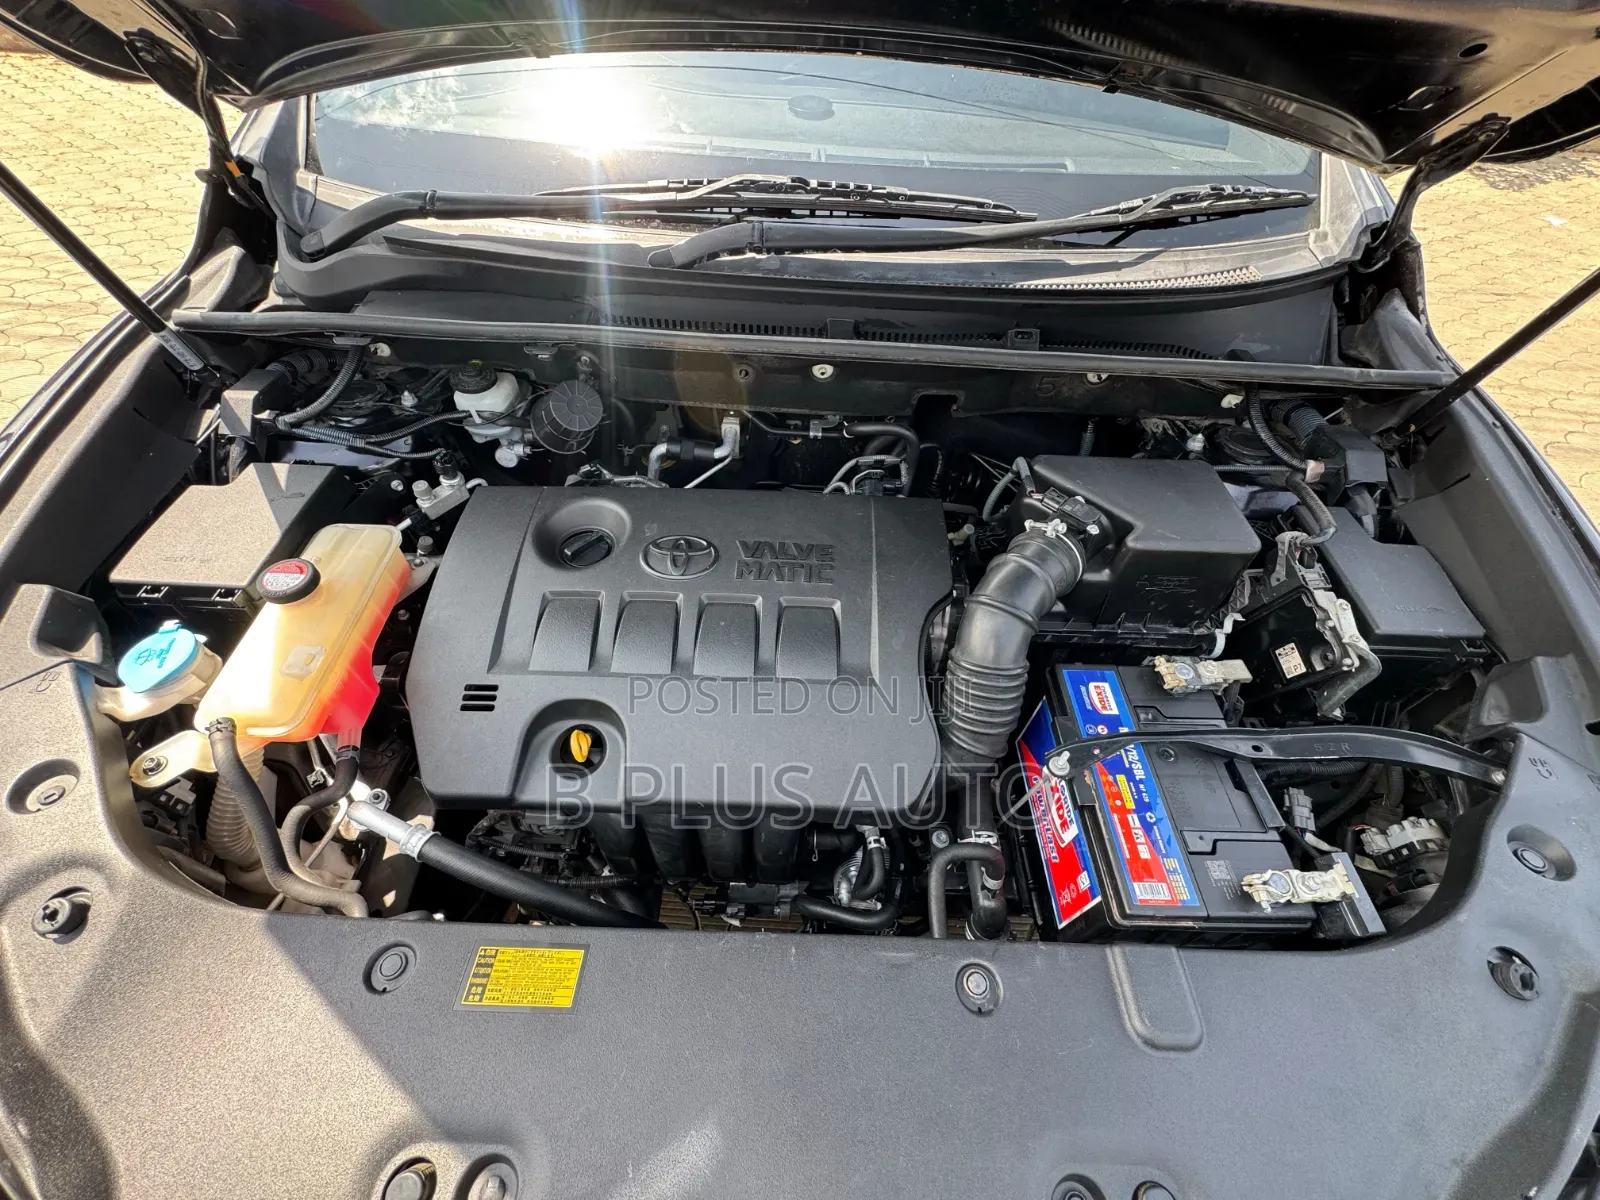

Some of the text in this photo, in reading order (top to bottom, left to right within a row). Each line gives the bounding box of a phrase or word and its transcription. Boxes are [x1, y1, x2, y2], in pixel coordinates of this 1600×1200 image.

[736, 540, 835, 562] VALVE
[735, 560, 834, 585] MATIC
[1292, 662, 1303, 674] P7
[1094, 685, 1108, 711] EXIDE
[1101, 685, 1114, 711] CHLORIDE
